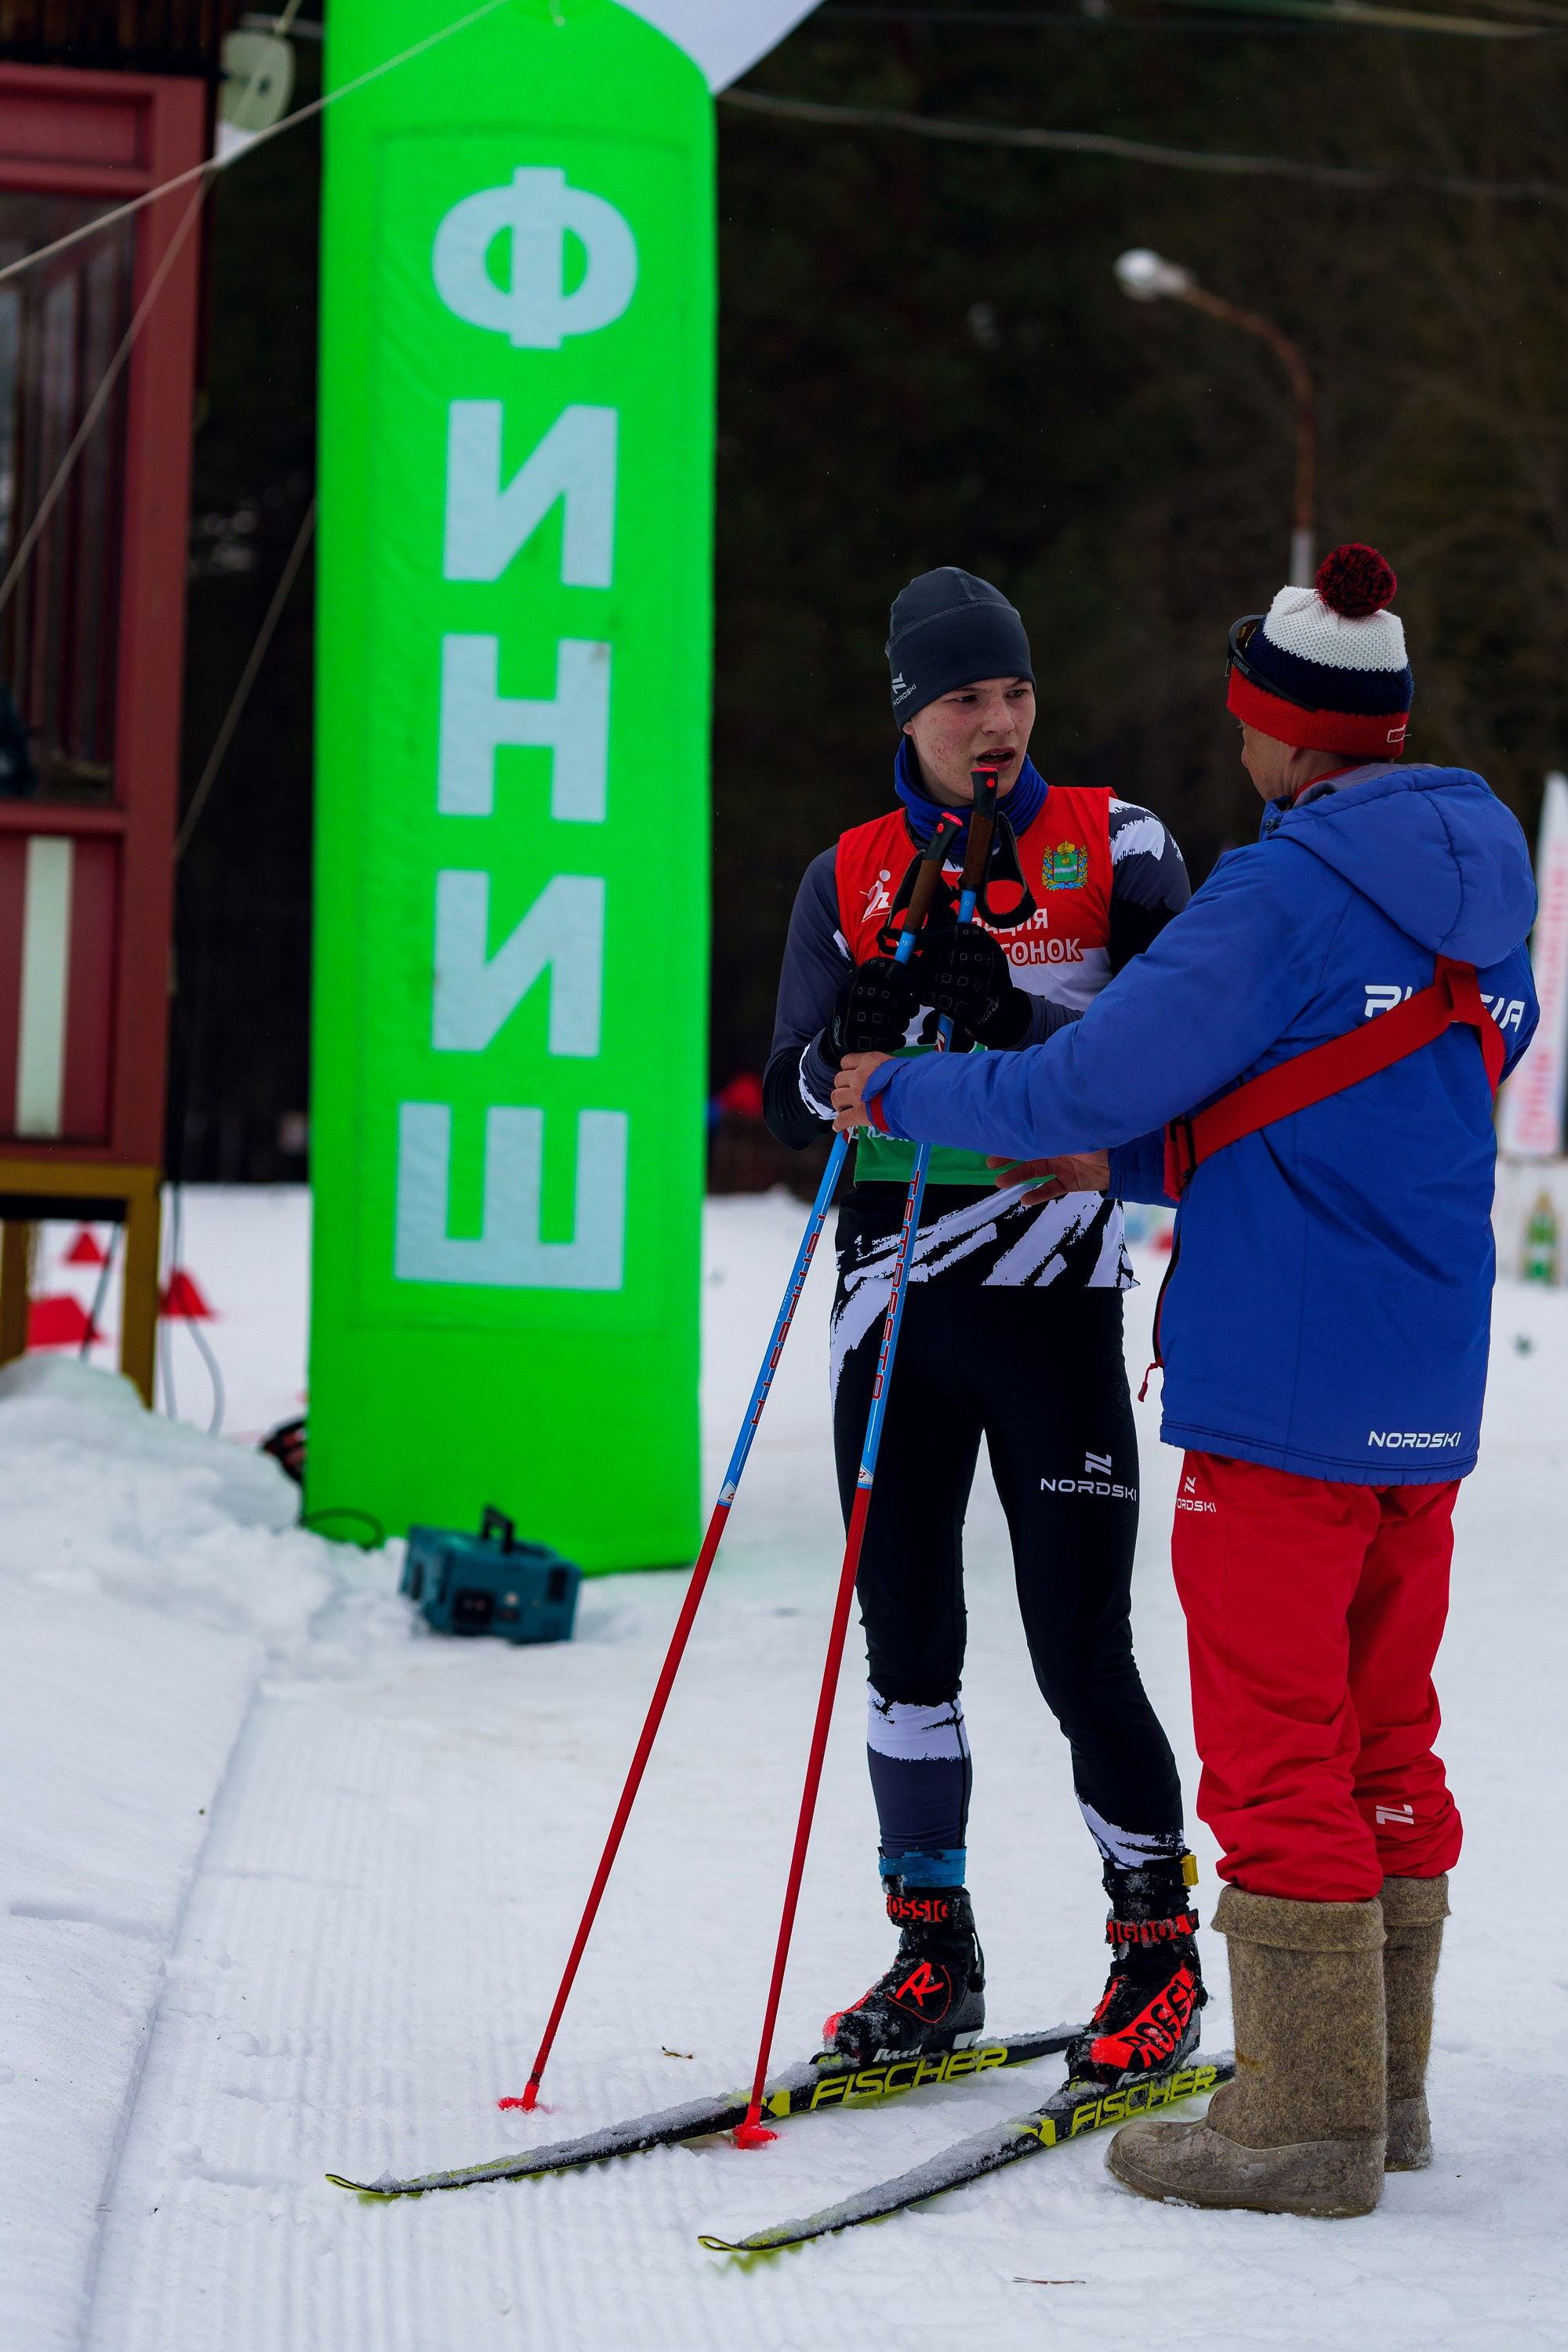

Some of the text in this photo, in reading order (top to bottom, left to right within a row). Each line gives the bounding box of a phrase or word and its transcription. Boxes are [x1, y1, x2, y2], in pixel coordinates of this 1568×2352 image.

[394, 165, 640, 1291] ФИНИШ
[1364, 985, 1526, 1033] RIA
[1367, 1431, 1461, 1448] NORDSKI
[1040, 1478, 1138, 1502] NORDSKI
[1176, 1497, 1217, 1513] ORDSKI
[809, 2047, 1009, 2110] FISCHER
[1071, 2065, 1218, 2137] FISCHER
